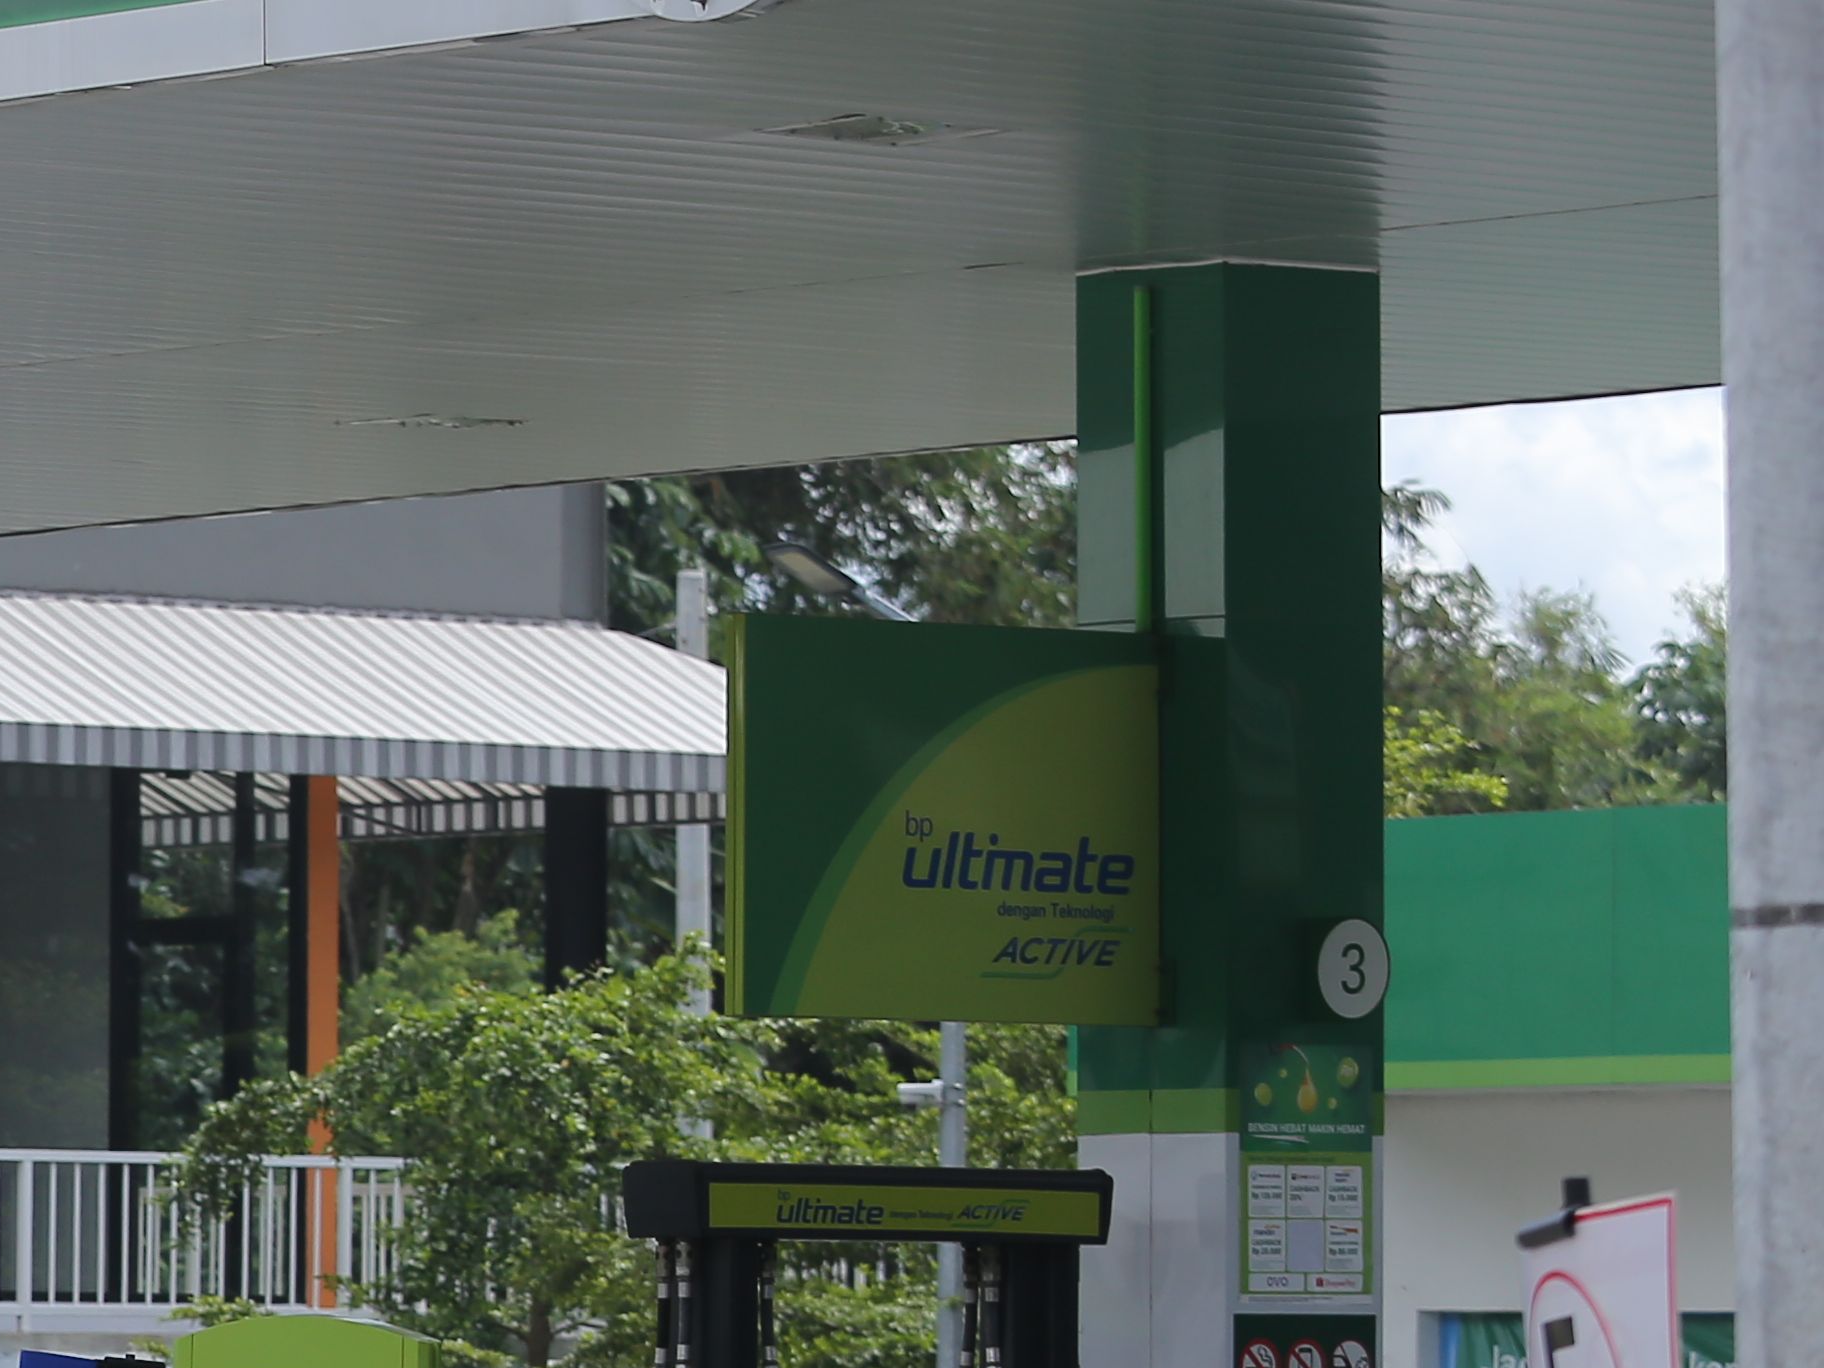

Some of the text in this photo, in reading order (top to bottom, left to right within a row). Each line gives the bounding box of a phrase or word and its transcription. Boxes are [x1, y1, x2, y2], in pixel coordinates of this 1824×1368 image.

[905, 810, 933, 842] bp
[903, 831, 1135, 895] ultimate
[997, 901, 1114, 922] dengan Teknologi
[992, 937, 1121, 966] ACTIVE
[1341, 943, 1365, 995] 3
[776, 1198, 884, 1225] ultimate
[958, 1205, 1027, 1221] ACTIVE
